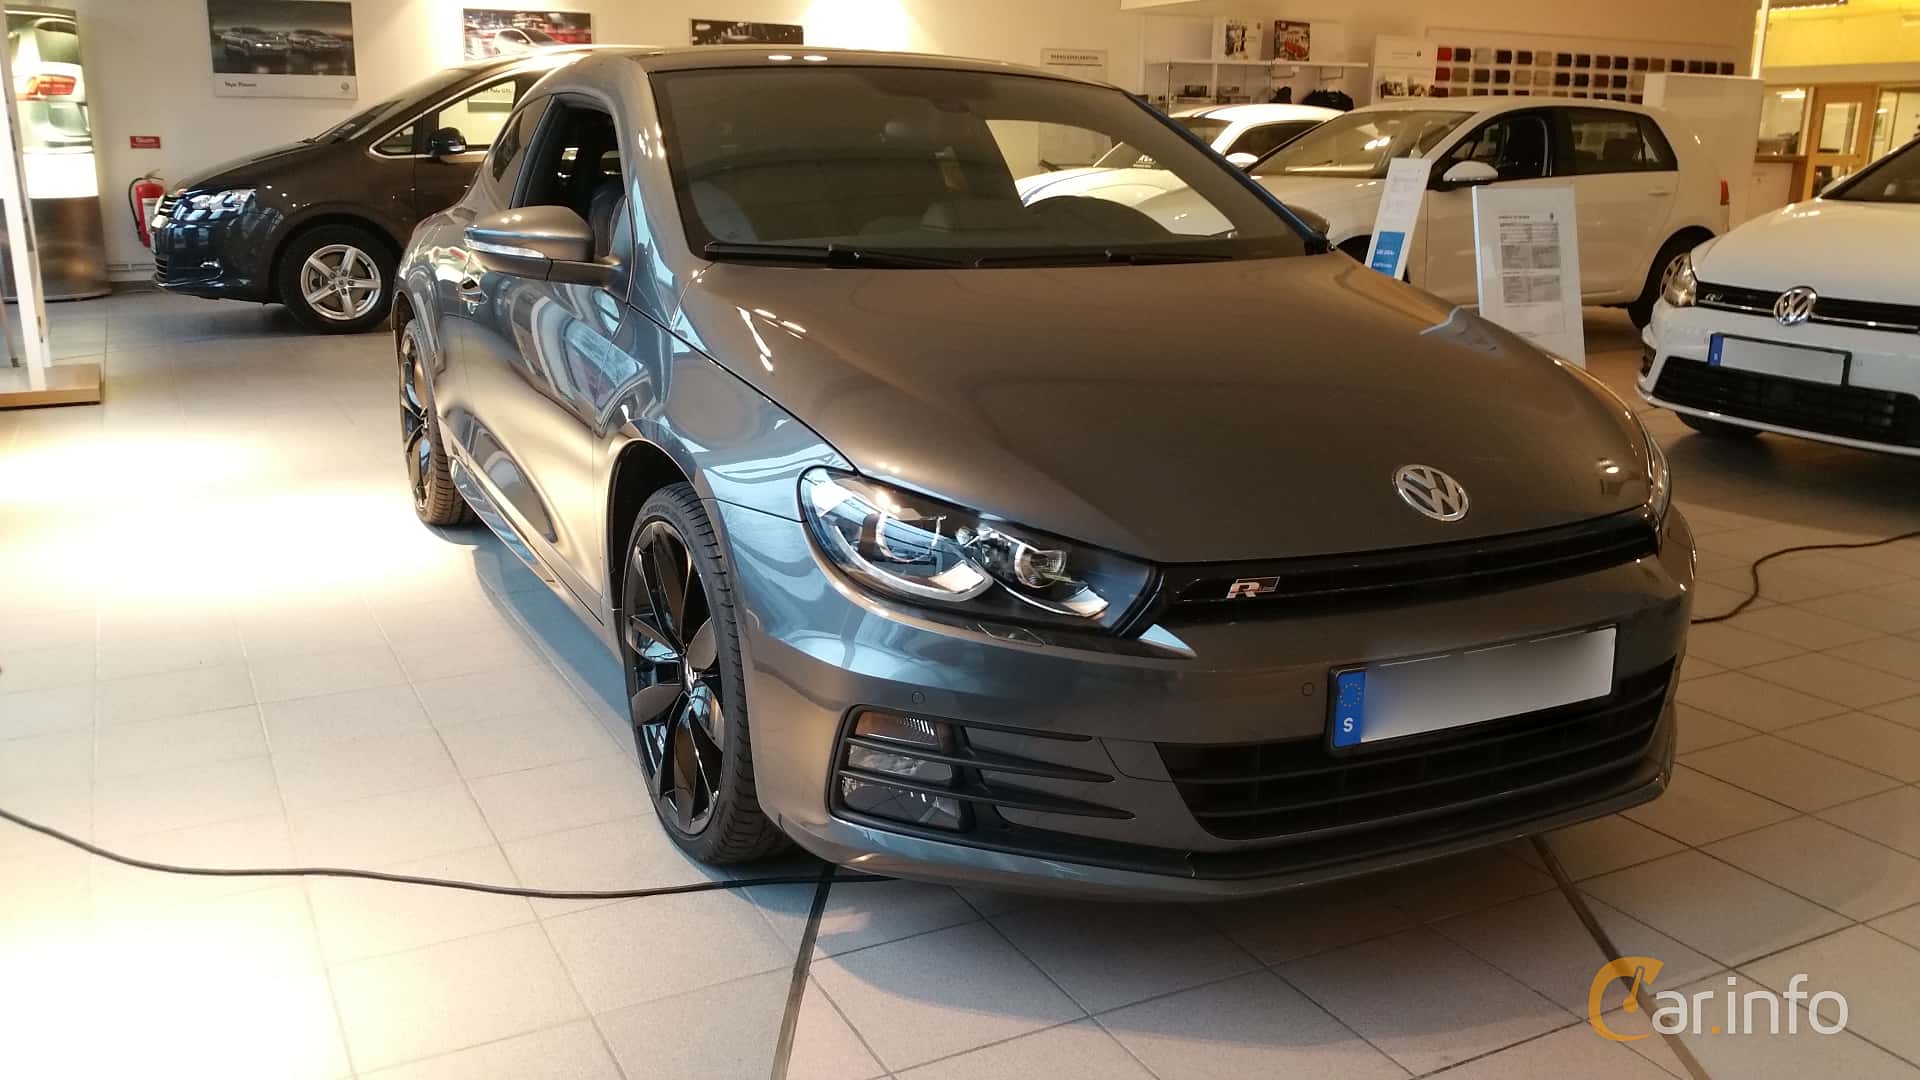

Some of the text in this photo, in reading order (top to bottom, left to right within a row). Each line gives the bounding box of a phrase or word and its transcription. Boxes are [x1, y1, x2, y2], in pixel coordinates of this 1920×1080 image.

[1395, 464, 1469, 522] VW
[1226, 581, 1261, 599] R
[1343, 717, 1354, 732] S
